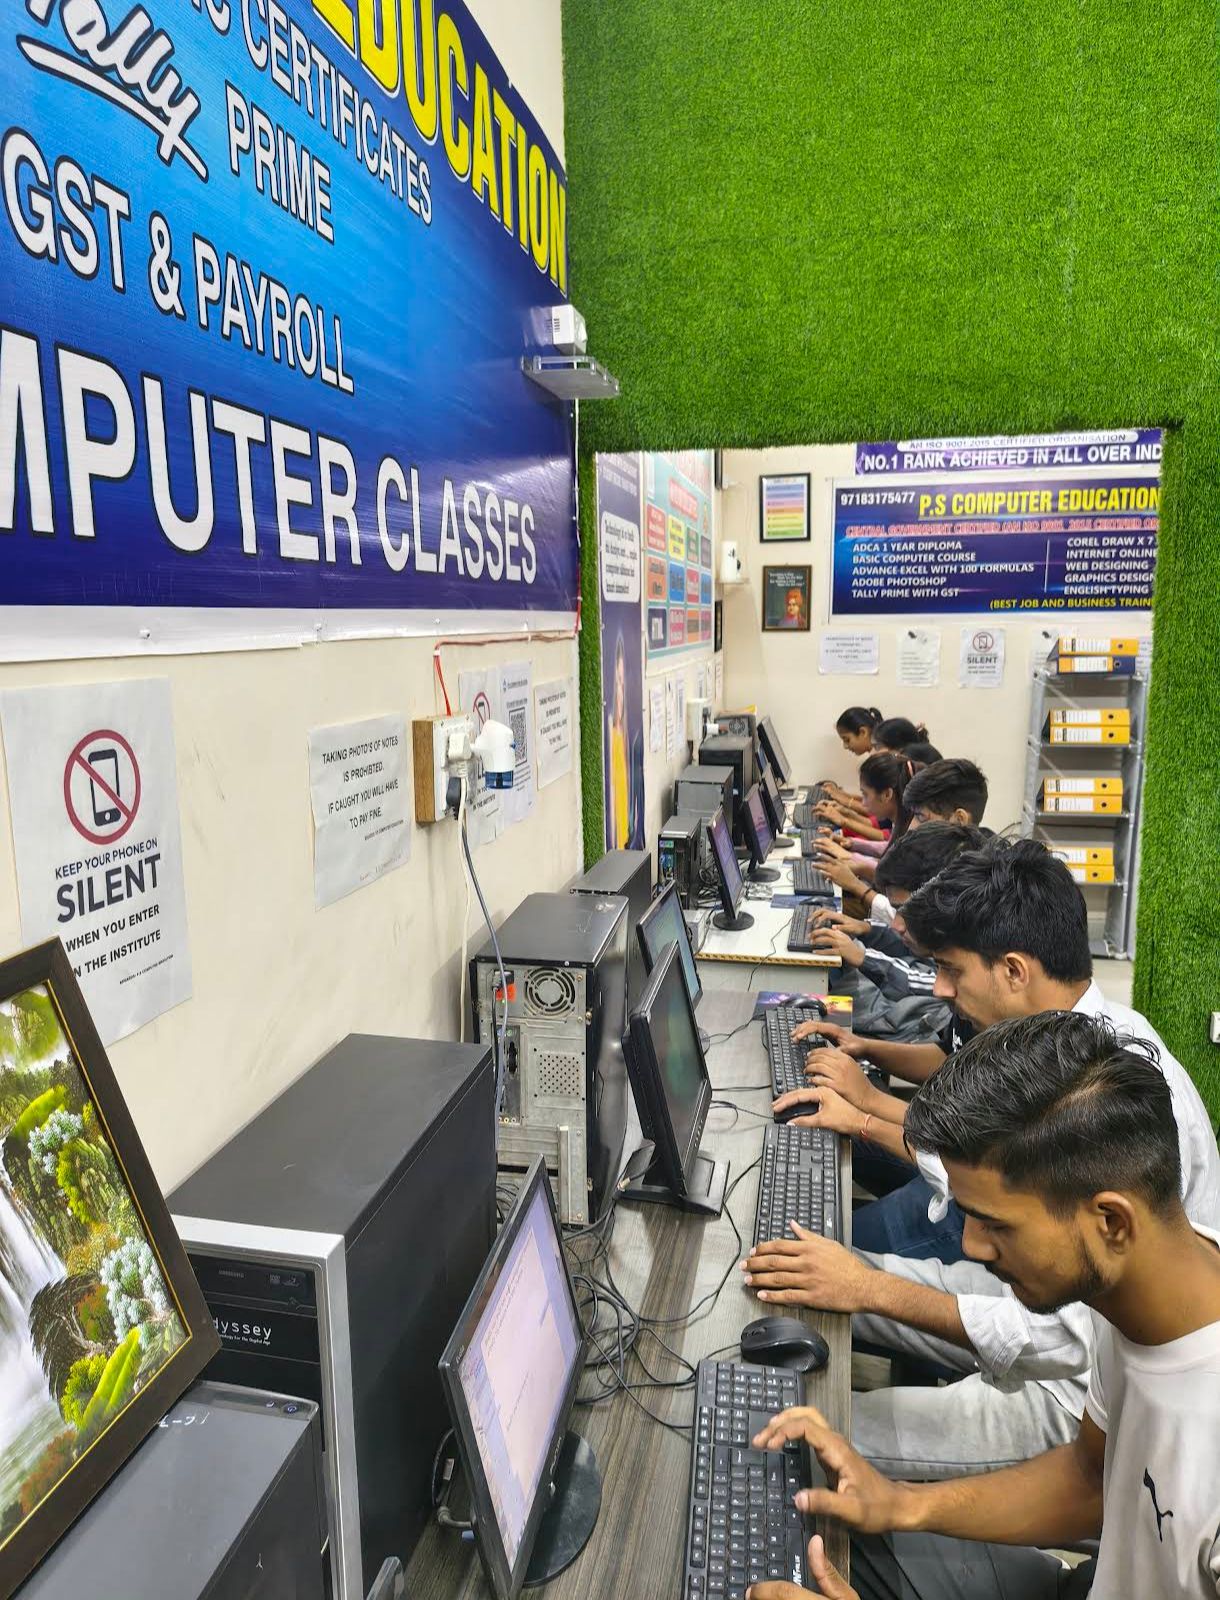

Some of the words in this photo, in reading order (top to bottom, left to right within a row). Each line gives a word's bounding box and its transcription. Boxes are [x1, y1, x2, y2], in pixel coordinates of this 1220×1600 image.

[17, 0, 208, 183] ally
[241, 0, 434, 226] CERTIFICATES
[225, 79, 334, 243] PRIME
[304, 0, 567, 299] DUCATION
[2, 127, 130, 293] GST
[148, 211, 186, 320] &
[193, 234, 354, 395] PAYROLL
[864, 454, 898, 471] NO.1
[904, 452, 946, 469] RANK
[950, 447, 1028, 468] ACHIEVED
[1032, 448, 1050, 464] IN
[1053, 447, 1082, 464] ALL
[1087, 445, 1130, 462] OVER
[919, 494, 946, 516] P.S
[951, 490, 1052, 515] COMPUTER
[1057, 486, 1161, 512] EDUCATION
[376, 455, 537, 584] CLASSES
[852, 543, 880, 552] ADCA
[882, 543, 887, 551] 1
[890, 542, 915, 551] YEAR
[917, 541, 962, 551] DIPLOMA
[1067, 537, 1100, 547] COREL
[1102, 537, 1134, 546] DRAW
[1136, 536, 1145, 546] X
[1147, 536, 1153, 546] 7
[852, 554, 880, 564] BASIC
[882, 553, 935, 563] COMPUTER
[937, 552, 976, 562] COURSE
[1066, 549, 1116, 559] INTERNET
[852, 565, 897, 575] ADVANCE
[900, 565, 928, 574] EXCEL
[930, 564, 957, 574] WITH
[959, 564, 977, 573] 100
[979, 563, 1035, 573] FORMULAS
[1065, 561, 1088, 571] WEB
[1091, 561, 1149, 570] DESIGNING
[852, 577, 884, 587] ADOBE
[886, 576, 947, 586] PHOTOSHOP
[1063, 585, 1108, 595] ENGLISH
[1110, 584, 1149, 594] TYPING
[1064, 573, 1116, 583] GRAPHICS
[852, 589, 878, 599] TALLY
[880, 588, 910, 598] PRIME
[912, 588, 938, 597] WITH
[941, 587, 959, 597] GST
[990, 599, 1017, 610] (BEST
[1019, 599, 1039, 609] JOB
[1041, 599, 1065, 608] AND
[1067, 598, 1116, 608] BUSINESS
[967, 656, 997, 664] SILENT
[322, 748, 347, 765] TAKING
[348, 741, 373, 759] PHOTO'S
[373, 739, 381, 751] OF
[381, 735, 399, 749] NOTES
[343, 770, 350, 783] IS
[328, 802, 334, 815] IF
[335, 793, 360, 812] CAUGHT
[361, 789, 371, 802] YOU
[372, 784, 384, 798] WILL
[385, 778, 399, 792] HAVE
[349, 816, 359, 829] TO
[359, 811, 369, 826] PAY
[55, 861, 83, 879] KEEP
[84, 852, 111, 870] YOUR
[112, 843, 145, 860] PHONE
[145, 837, 158, 852] ON
[56, 853, 161, 924] SILENT
[65, 929, 100, 953] WHEN
[102, 918, 126, 937] YOU
[129, 904, 160, 927] ENTER
[73, 965, 82, 978] N
[84, 954, 107, 975] THE
[109, 929, 161, 963] INSTITUTE
[212, 1317, 272, 1340] dyssey
